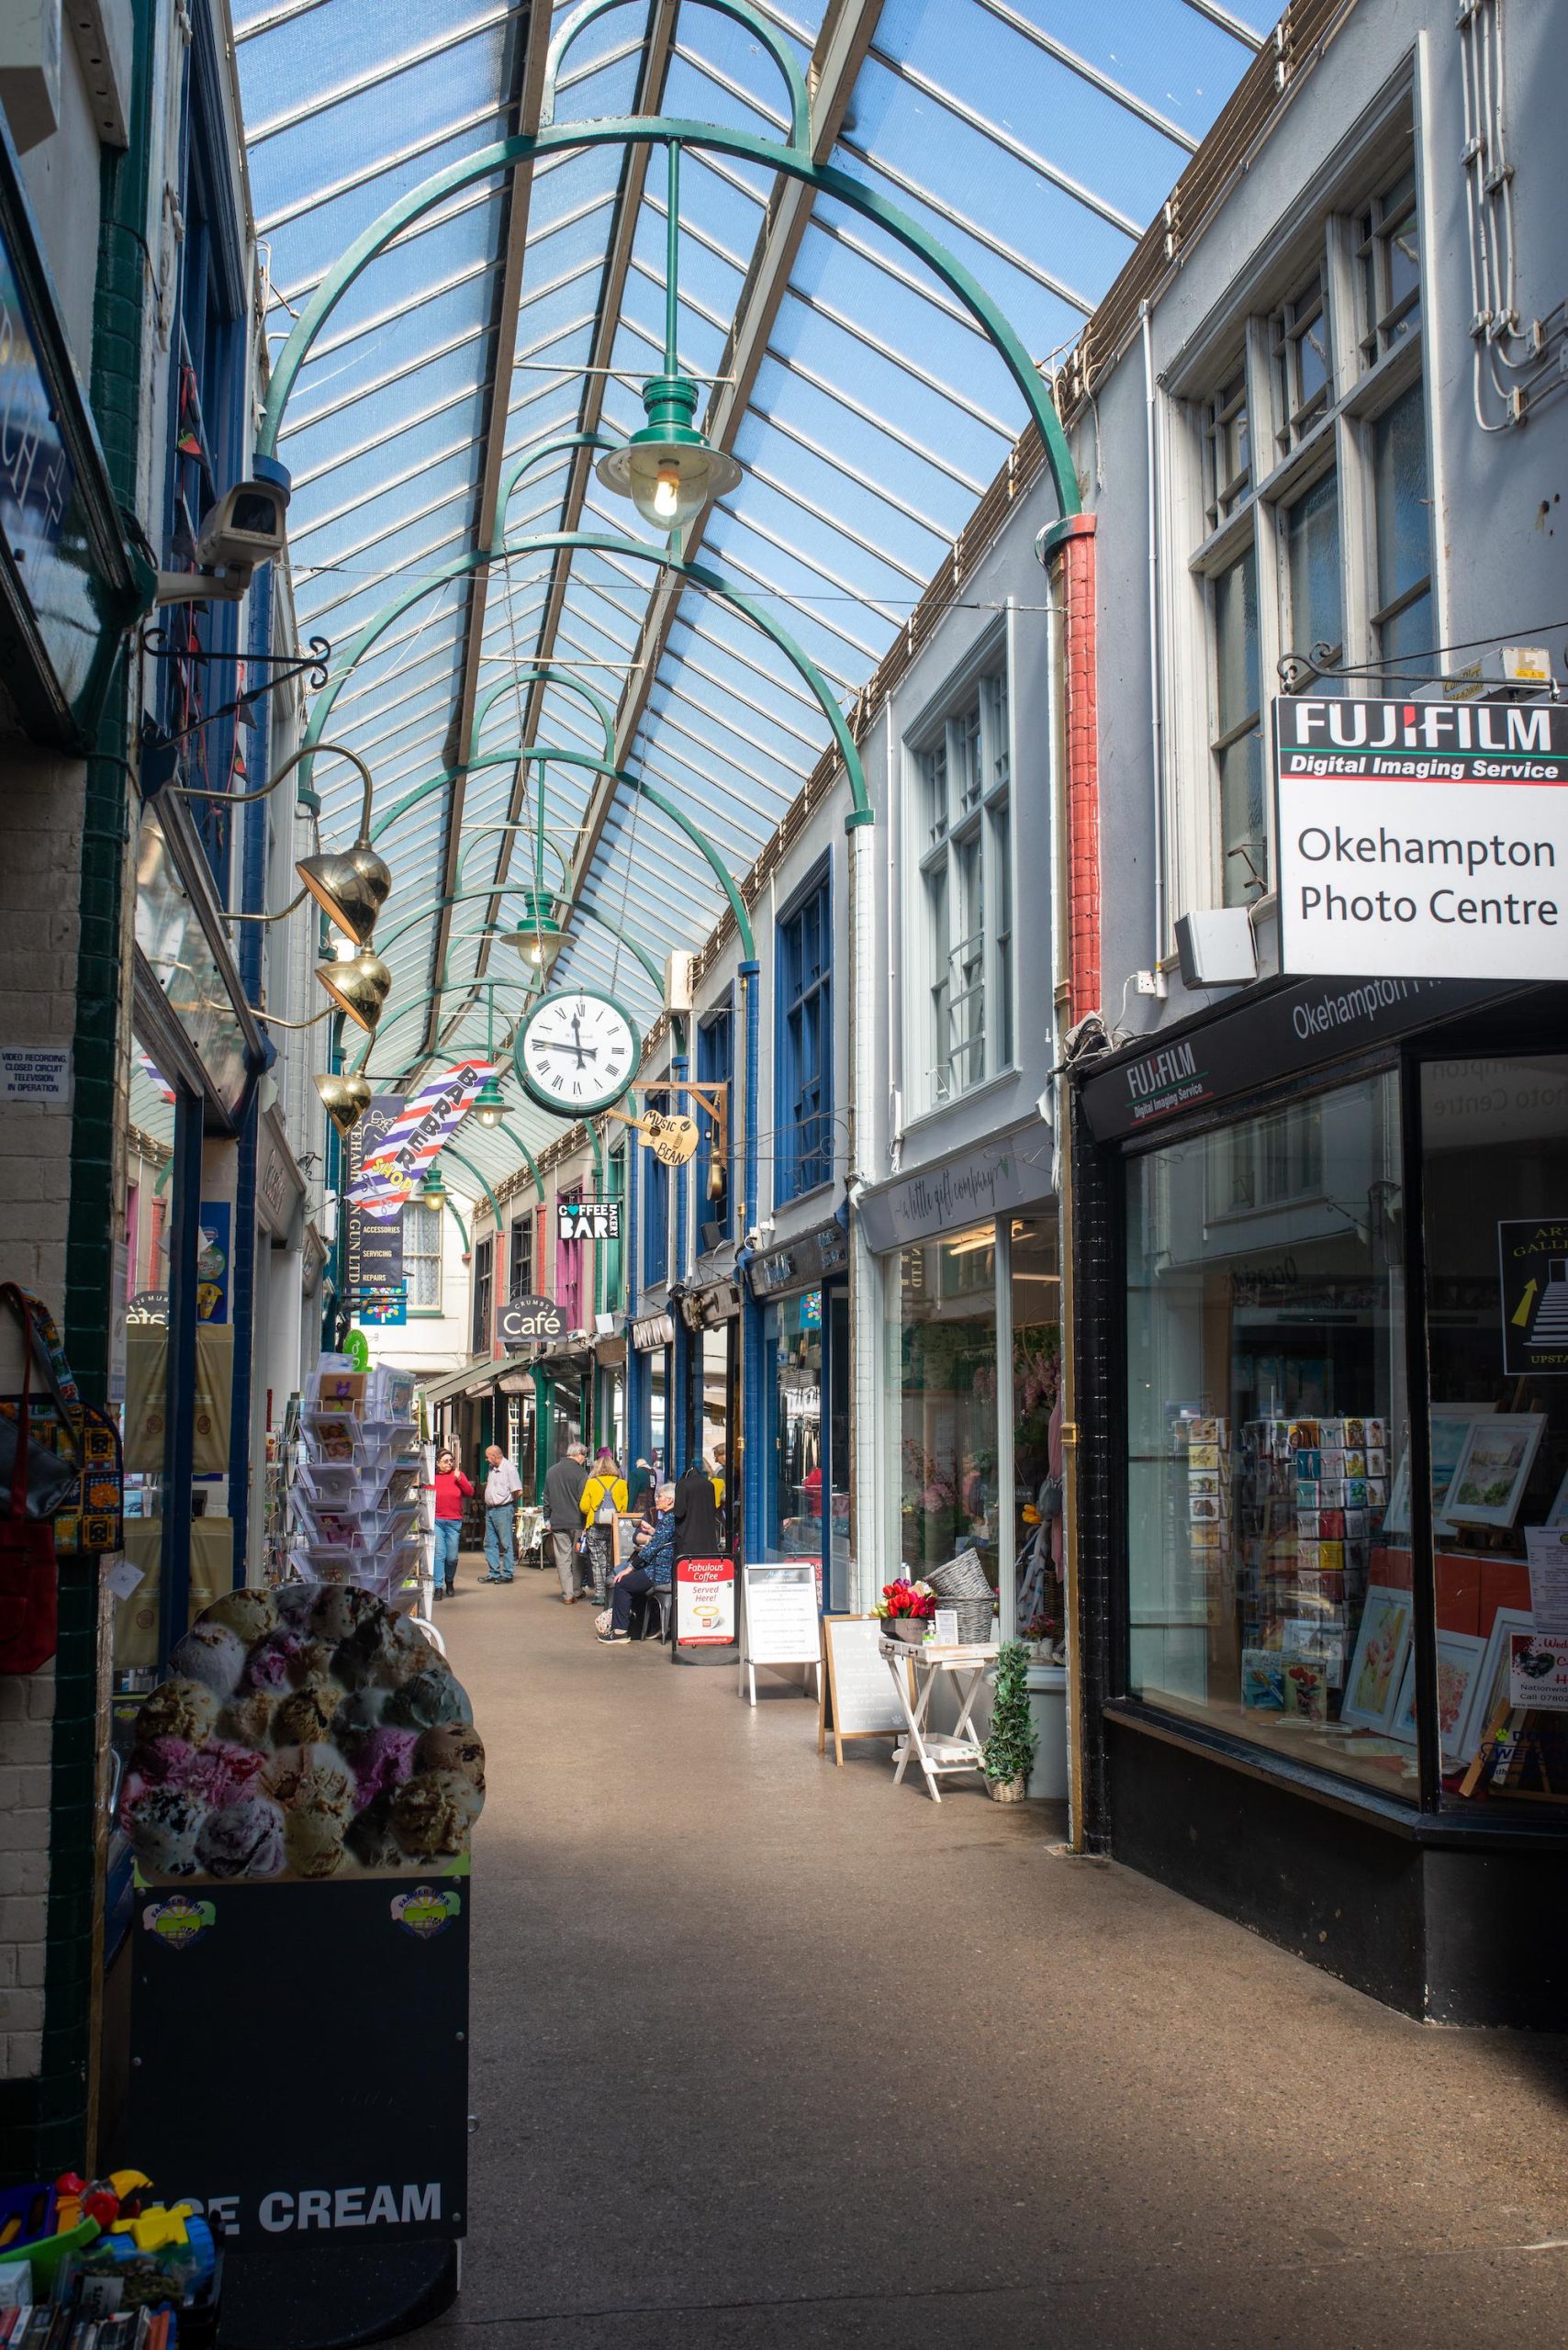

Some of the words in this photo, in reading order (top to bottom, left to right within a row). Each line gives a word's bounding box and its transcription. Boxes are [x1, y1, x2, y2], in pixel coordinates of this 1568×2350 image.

[1295, 703, 1551, 752] FUJIFILM
[1290, 755, 1366, 777] Digital
[1372, 757, 1465, 780] Imaging
[1472, 759, 1559, 779] Service
[1298, 826, 1556, 877] Okehampton
[1301, 884, 1417, 923] Photo
[1429, 889, 1559, 926] Centre
[2, 1053, 23, 1061] VIDEO
[35, 1064, 63, 1072] CIRCUIT
[14, 1074, 54, 1082] TELEVISION
[1126, 1042, 1197, 1099] FUJIFILM
[7, 1083, 16, 1091] IN
[17, 1084, 59, 1092] OPERATION
[1134, 1100, 1154, 1118] Digital
[1153, 1093, 1179, 1111] Imaging
[1178, 1083, 1203, 1101] Service
[394, 1065, 479, 1173] BARBER
[643, 1111, 677, 1132] MUSIC
[657, 1142, 685, 1164] BEAN
[372, 1158, 413, 1192] SHOP
[934, 1169, 953, 1225] gift
[363, 1225, 401, 1234] ACCESSORIES
[560, 1216, 608, 1238] BAR
[609, 1203, 619, 1237] BAKERY
[349, 1218, 361, 1251] GUN
[363, 1249, 392, 1258] SERVICING
[349, 1255, 361, 1284] LTD
[514, 1299, 550, 1310] CRUMBS
[503, 1309, 561, 1335] Café
[688, 1563, 723, 1572] Fabulous
[693, 1572, 718, 1583] Coffee
[258, 2182, 442, 2232] CREAM
